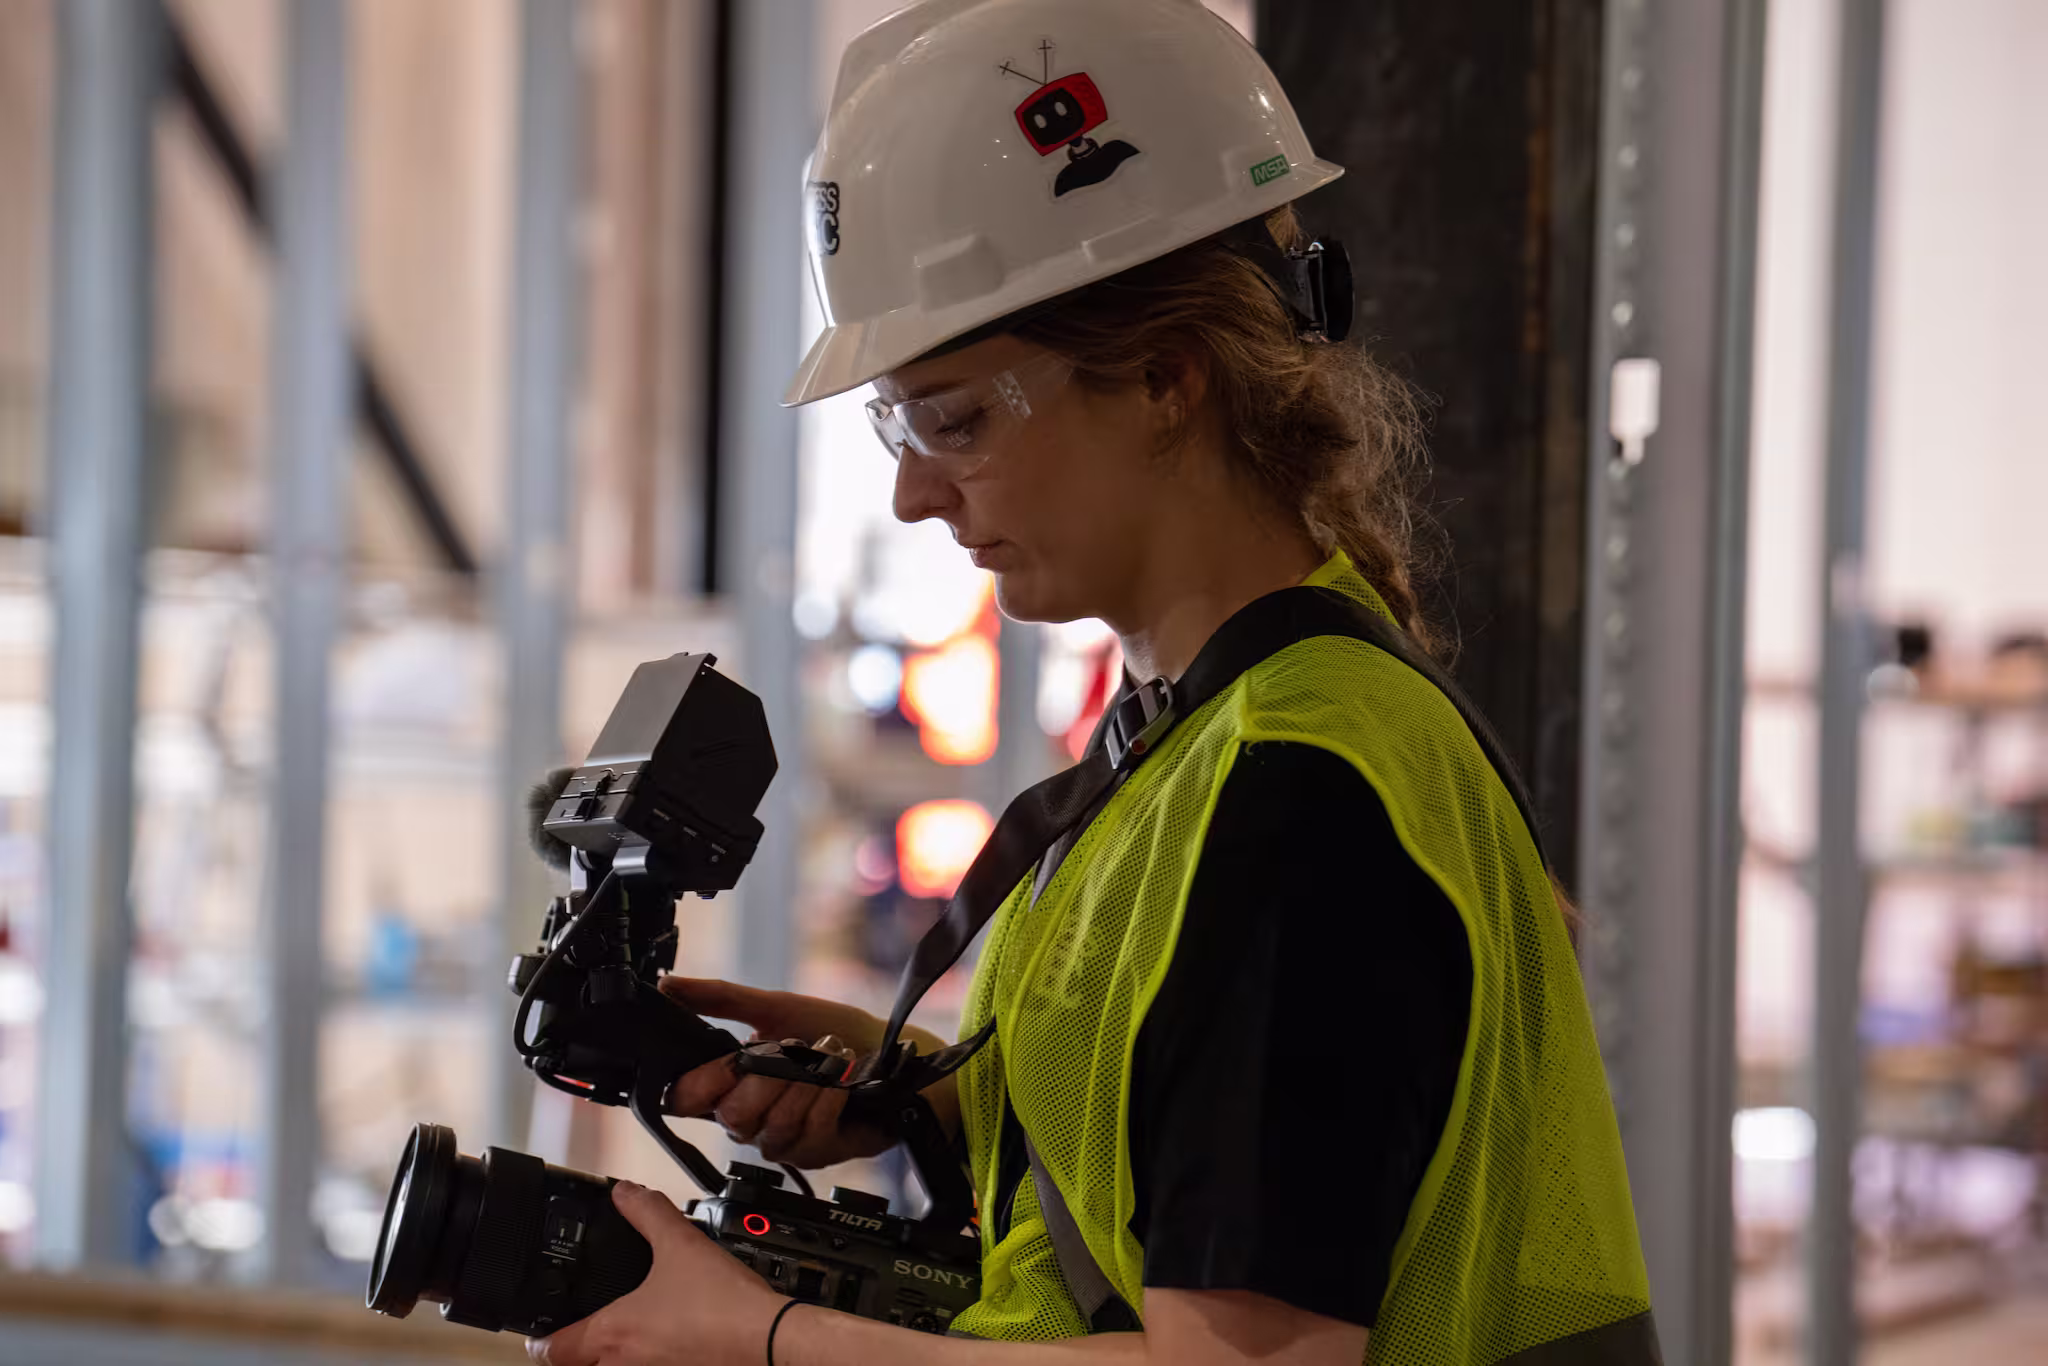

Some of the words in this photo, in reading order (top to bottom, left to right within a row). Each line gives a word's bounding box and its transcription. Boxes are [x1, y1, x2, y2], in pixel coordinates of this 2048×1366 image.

[1254, 158, 1287, 183] MSA
[828, 1208, 882, 1231] TILTA
[893, 1259, 974, 1289] SONY
